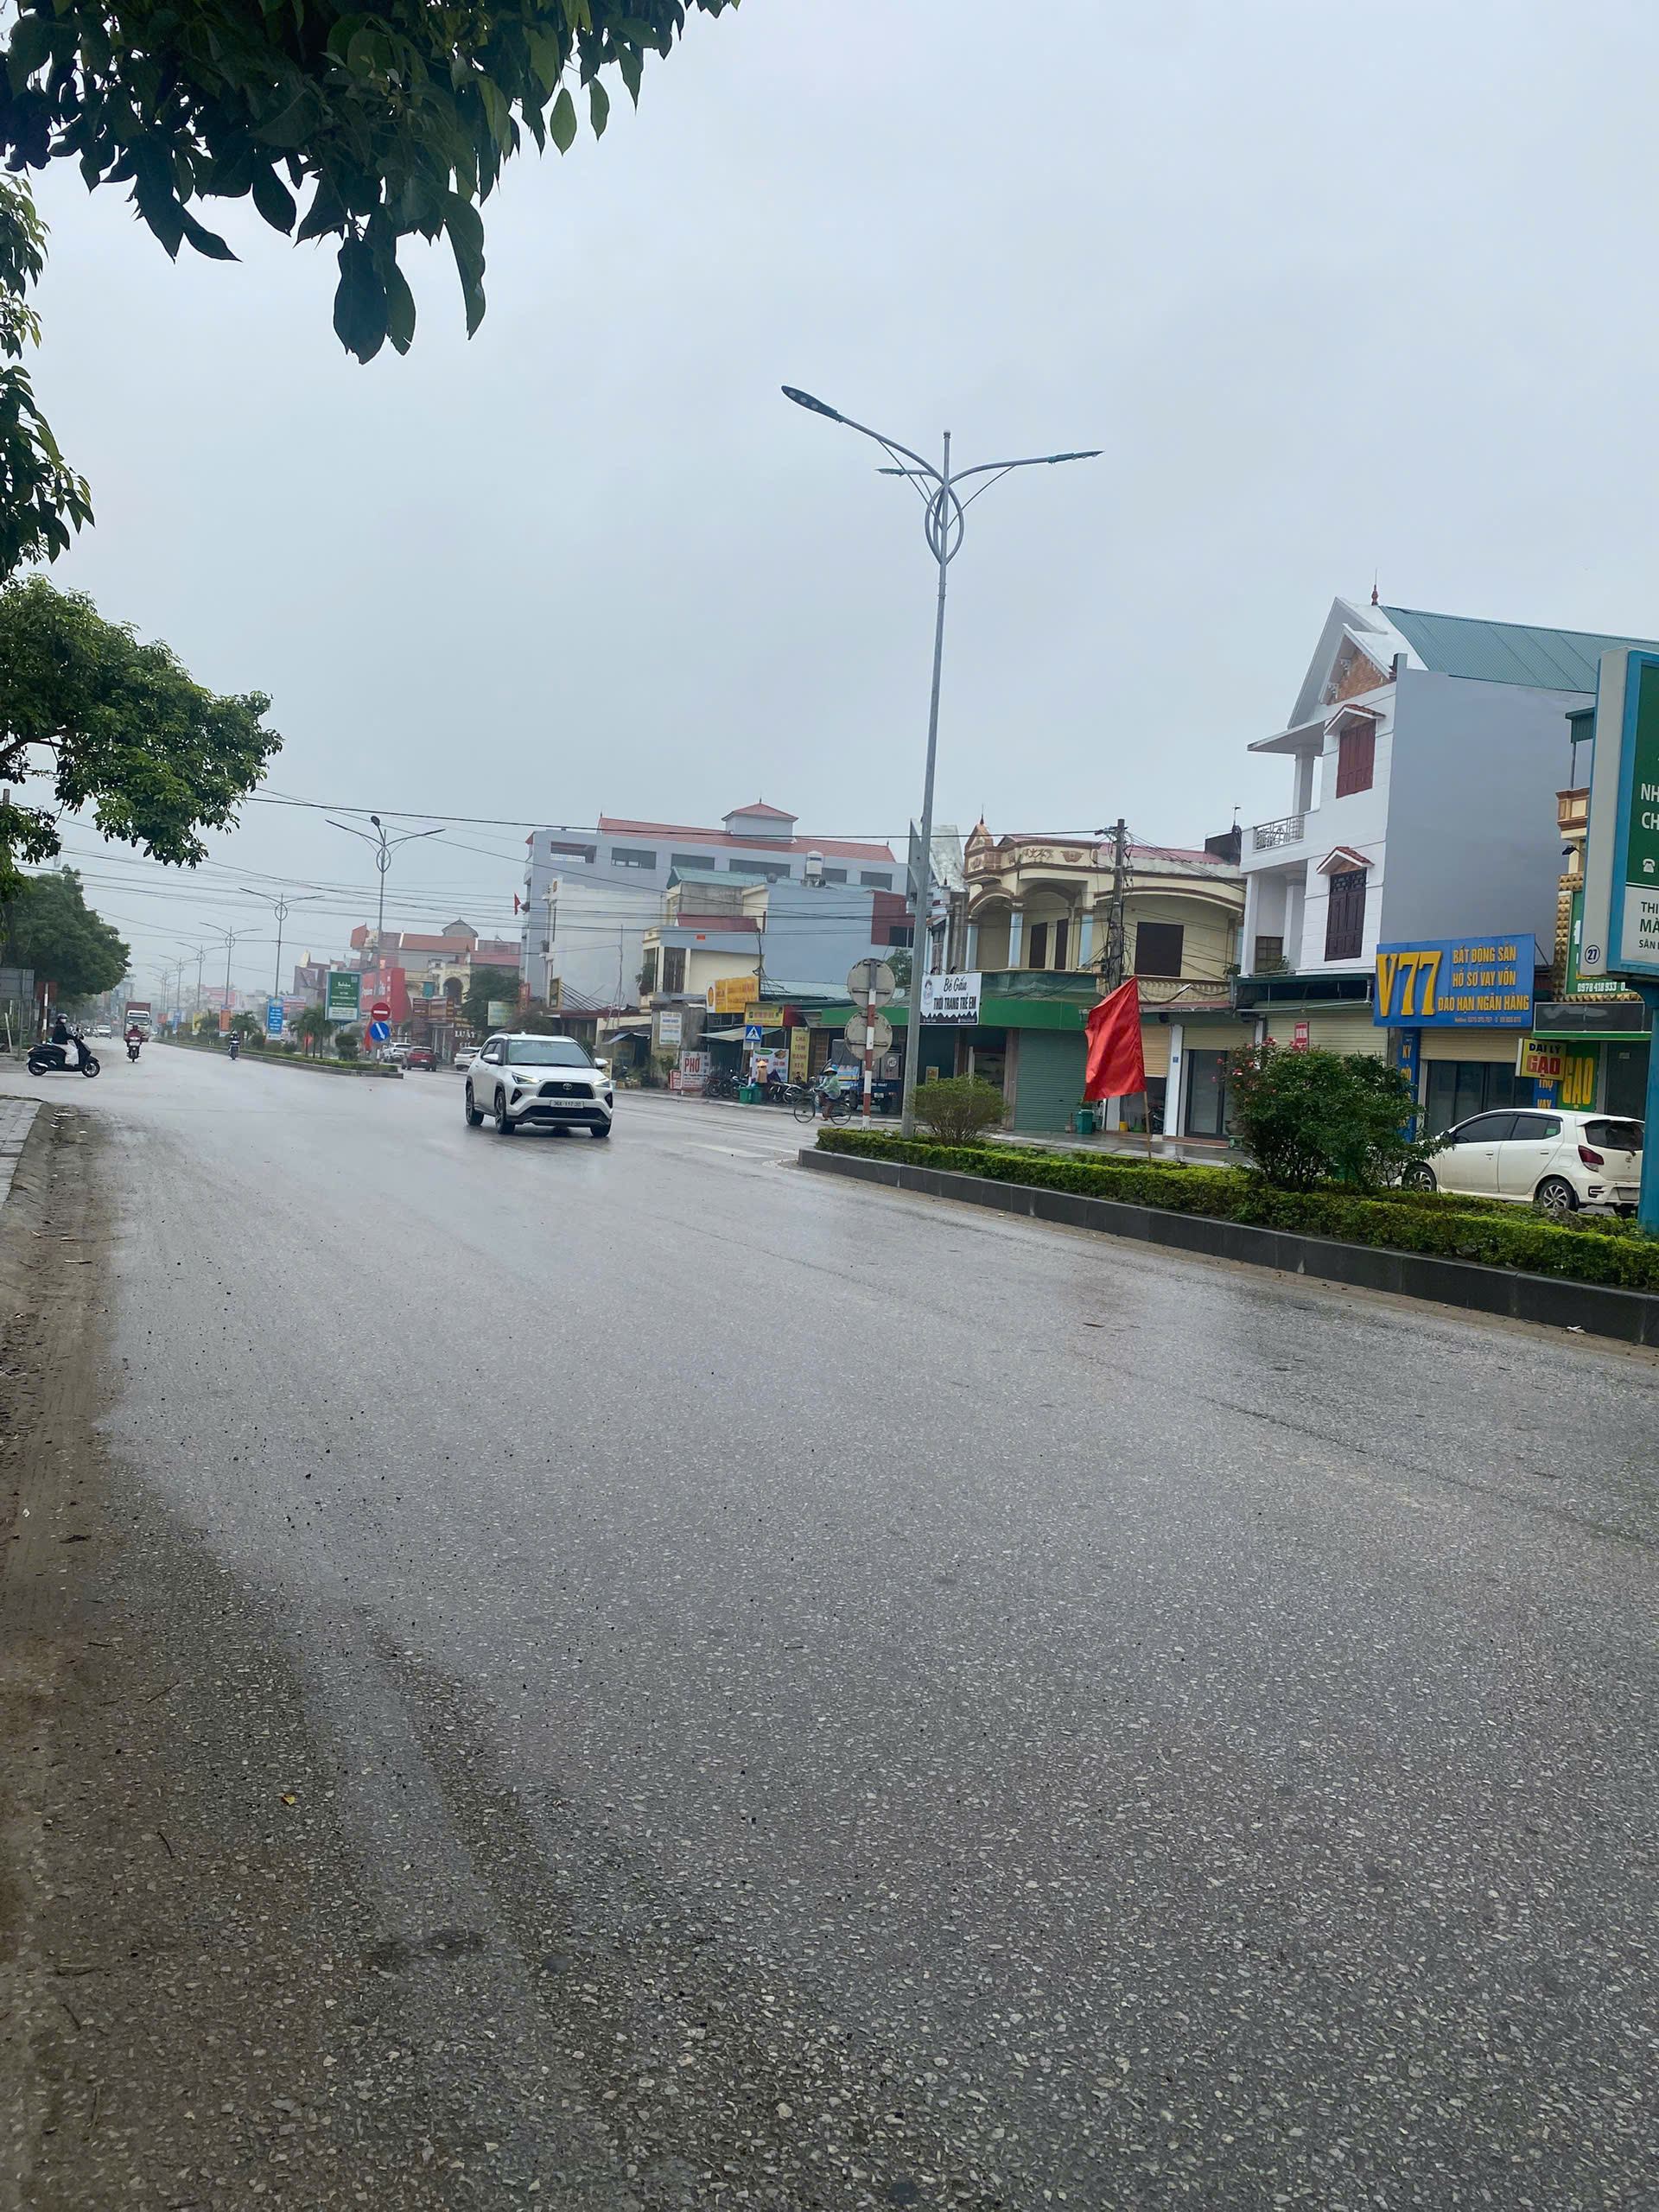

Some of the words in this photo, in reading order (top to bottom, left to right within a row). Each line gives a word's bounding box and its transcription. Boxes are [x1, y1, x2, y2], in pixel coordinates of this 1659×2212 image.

[1452, 944, 1469, 964] BẤT
[1471, 944, 1496, 966] ĐỘNG
[1497, 941, 1516, 962] SẢN
[1587, 949, 1598, 960] 27
[1376, 950, 1442, 1017] V77
[1452, 969, 1465, 988] HỒ
[1466, 970, 1478, 987] SƠ
[1480, 970, 1496, 987] VAY
[1497, 965, 1516, 986] VỐN
[944, 997, 959, 1010] TRANG
[969, 996, 976, 1009] EM
[1457, 995, 1475, 1014] HẠN
[1477, 992, 1502, 1011] NGÂN
[1503, 992, 1529, 1011] HÀNG
[1529, 1043, 1547, 1055] ĐẠI
[1550, 1043, 1561, 1054] LÝ
[1527, 1054, 1561, 1077] GẠO
[1562, 1057, 1594, 1109] GẠO
